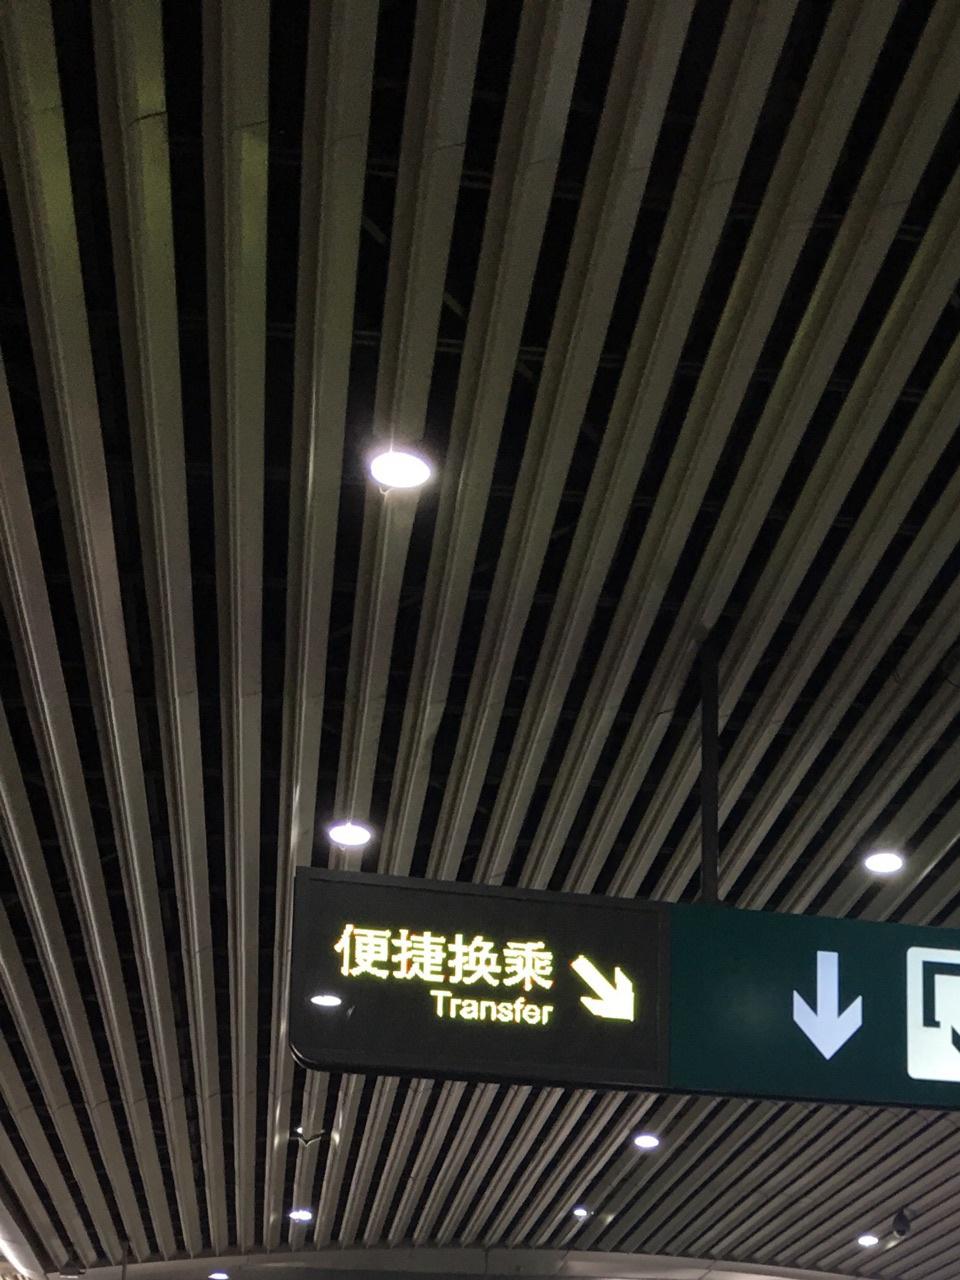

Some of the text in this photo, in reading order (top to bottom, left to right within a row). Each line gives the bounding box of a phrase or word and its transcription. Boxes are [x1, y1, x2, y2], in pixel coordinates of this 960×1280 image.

[333, 923, 554, 992] 便捷换乘
[429, 989, 555, 1026] Transfer
